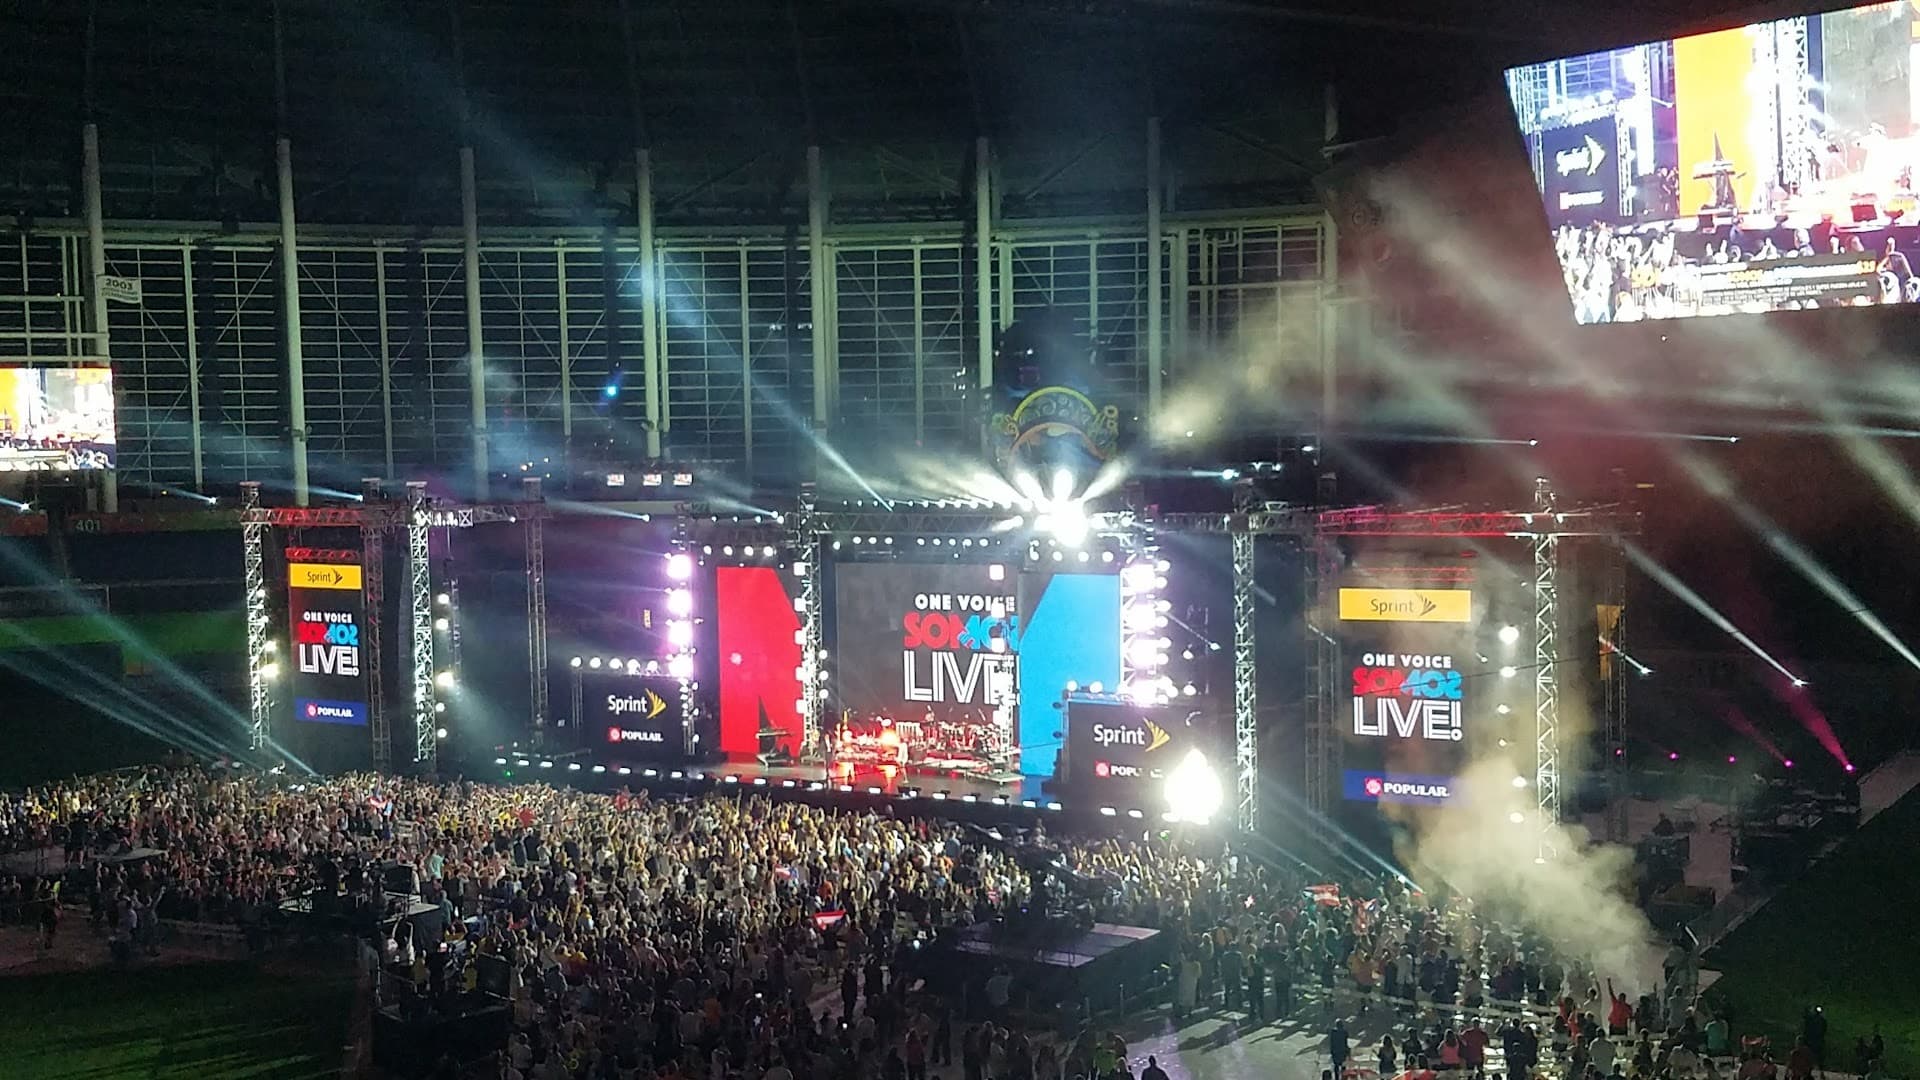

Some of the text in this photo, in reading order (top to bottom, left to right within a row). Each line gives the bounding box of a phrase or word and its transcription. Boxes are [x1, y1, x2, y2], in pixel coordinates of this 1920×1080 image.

[105, 278, 133, 290] 2003
[75, 519, 101, 531] 401
[307, 569, 331, 583] Sprint
[914, 593, 952, 610] ONE
[1370, 598, 1414, 615] Sprint
[303, 611, 353, 623] ONE VOICE
[299, 644, 360, 677] LIVE!
[1362, 653, 1452, 668] ONE VOICE
[607, 694, 647, 715] Sprint
[1353, 696, 1463, 741] LIVE!
[1093, 723, 1145, 747] Sprint
